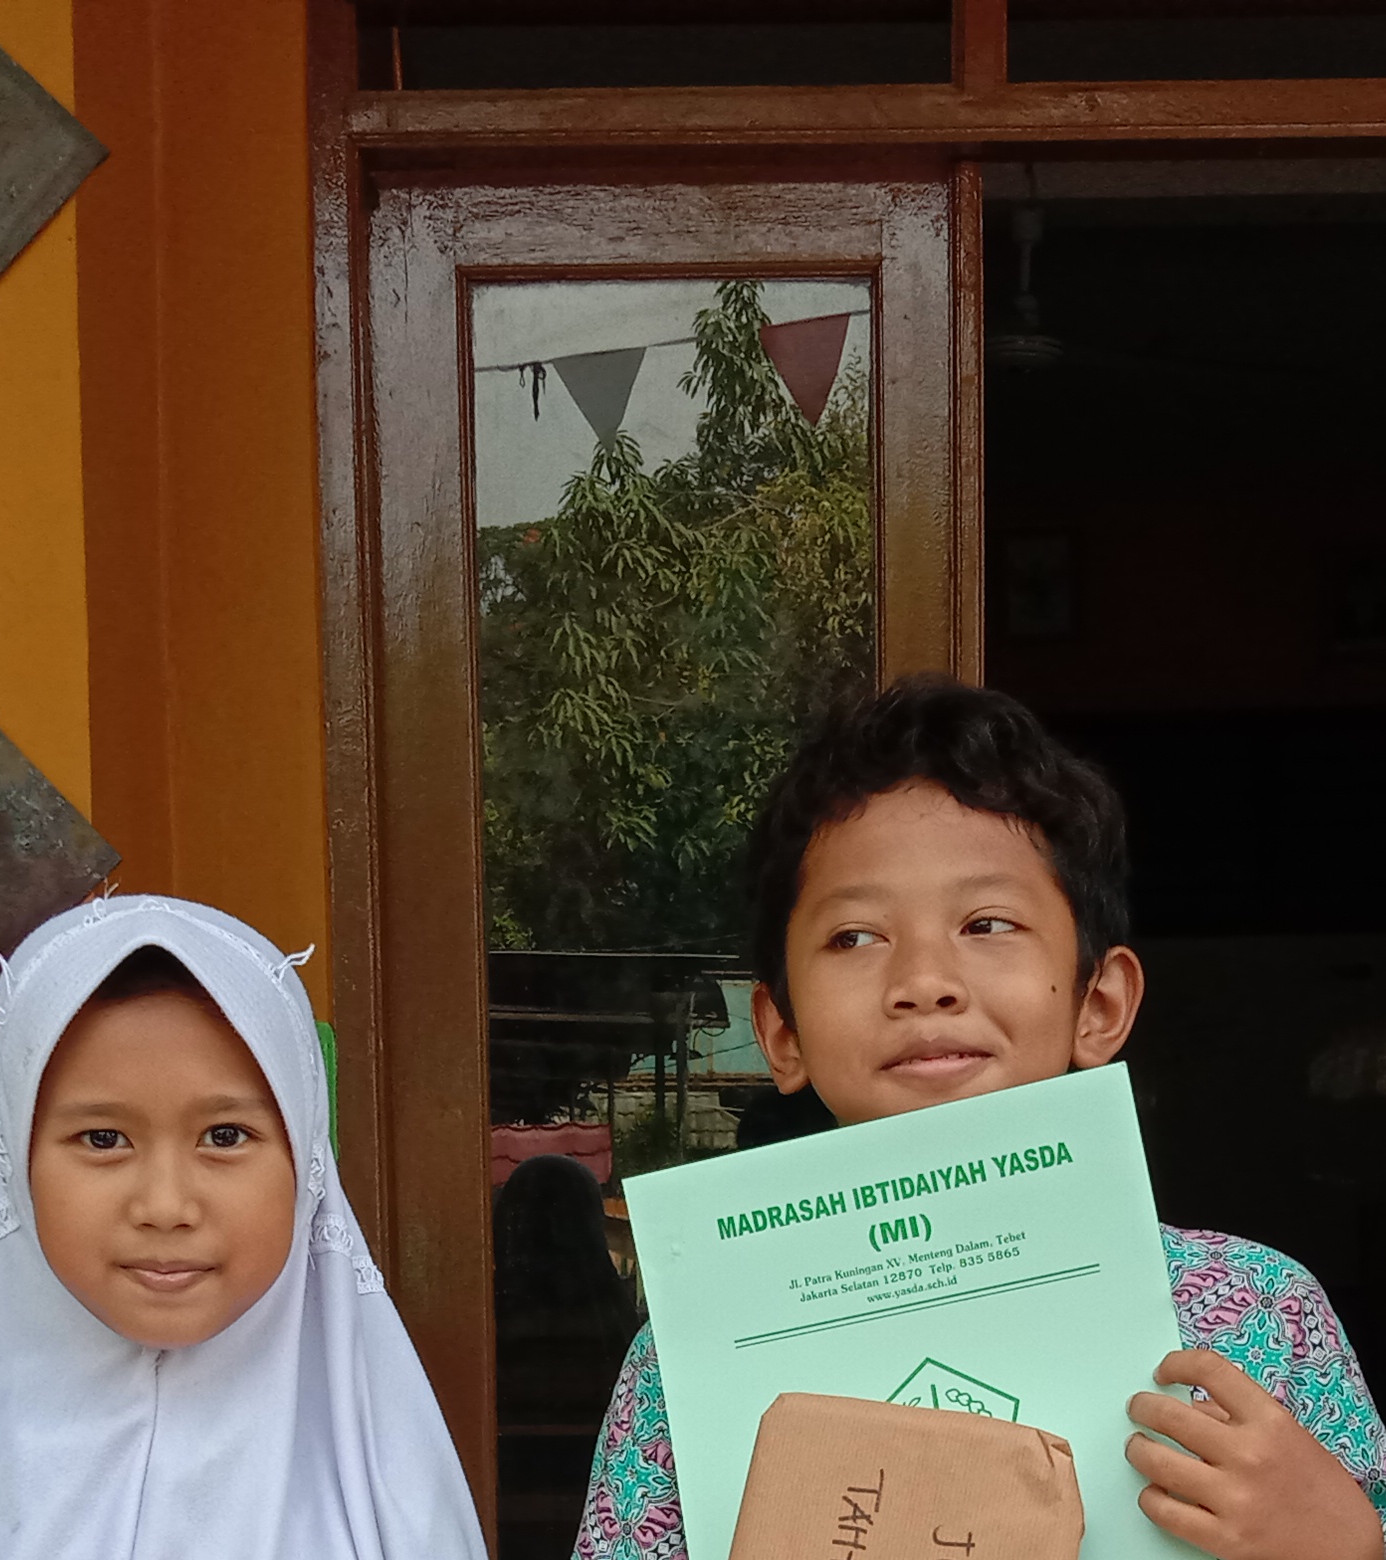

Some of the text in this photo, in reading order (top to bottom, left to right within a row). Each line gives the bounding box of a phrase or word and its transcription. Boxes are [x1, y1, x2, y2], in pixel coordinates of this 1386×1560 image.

[716, 1142, 1073, 1239] MADRASAH IBTIDAIYAH YASDA
[804, 1275, 832, 1287] Patra
[834, 1263, 884, 1280] Kuningan
[907, 1248, 953, 1263] Menteng
[995, 1231, 1026, 1245] Tebet
[868, 1213, 931, 1252] (MI)
[799, 1246, 1021, 1303] Jakarta Selatan 12870 Telp. 835 5865
[866, 1274, 957, 1303] www.yasda.sch.id
